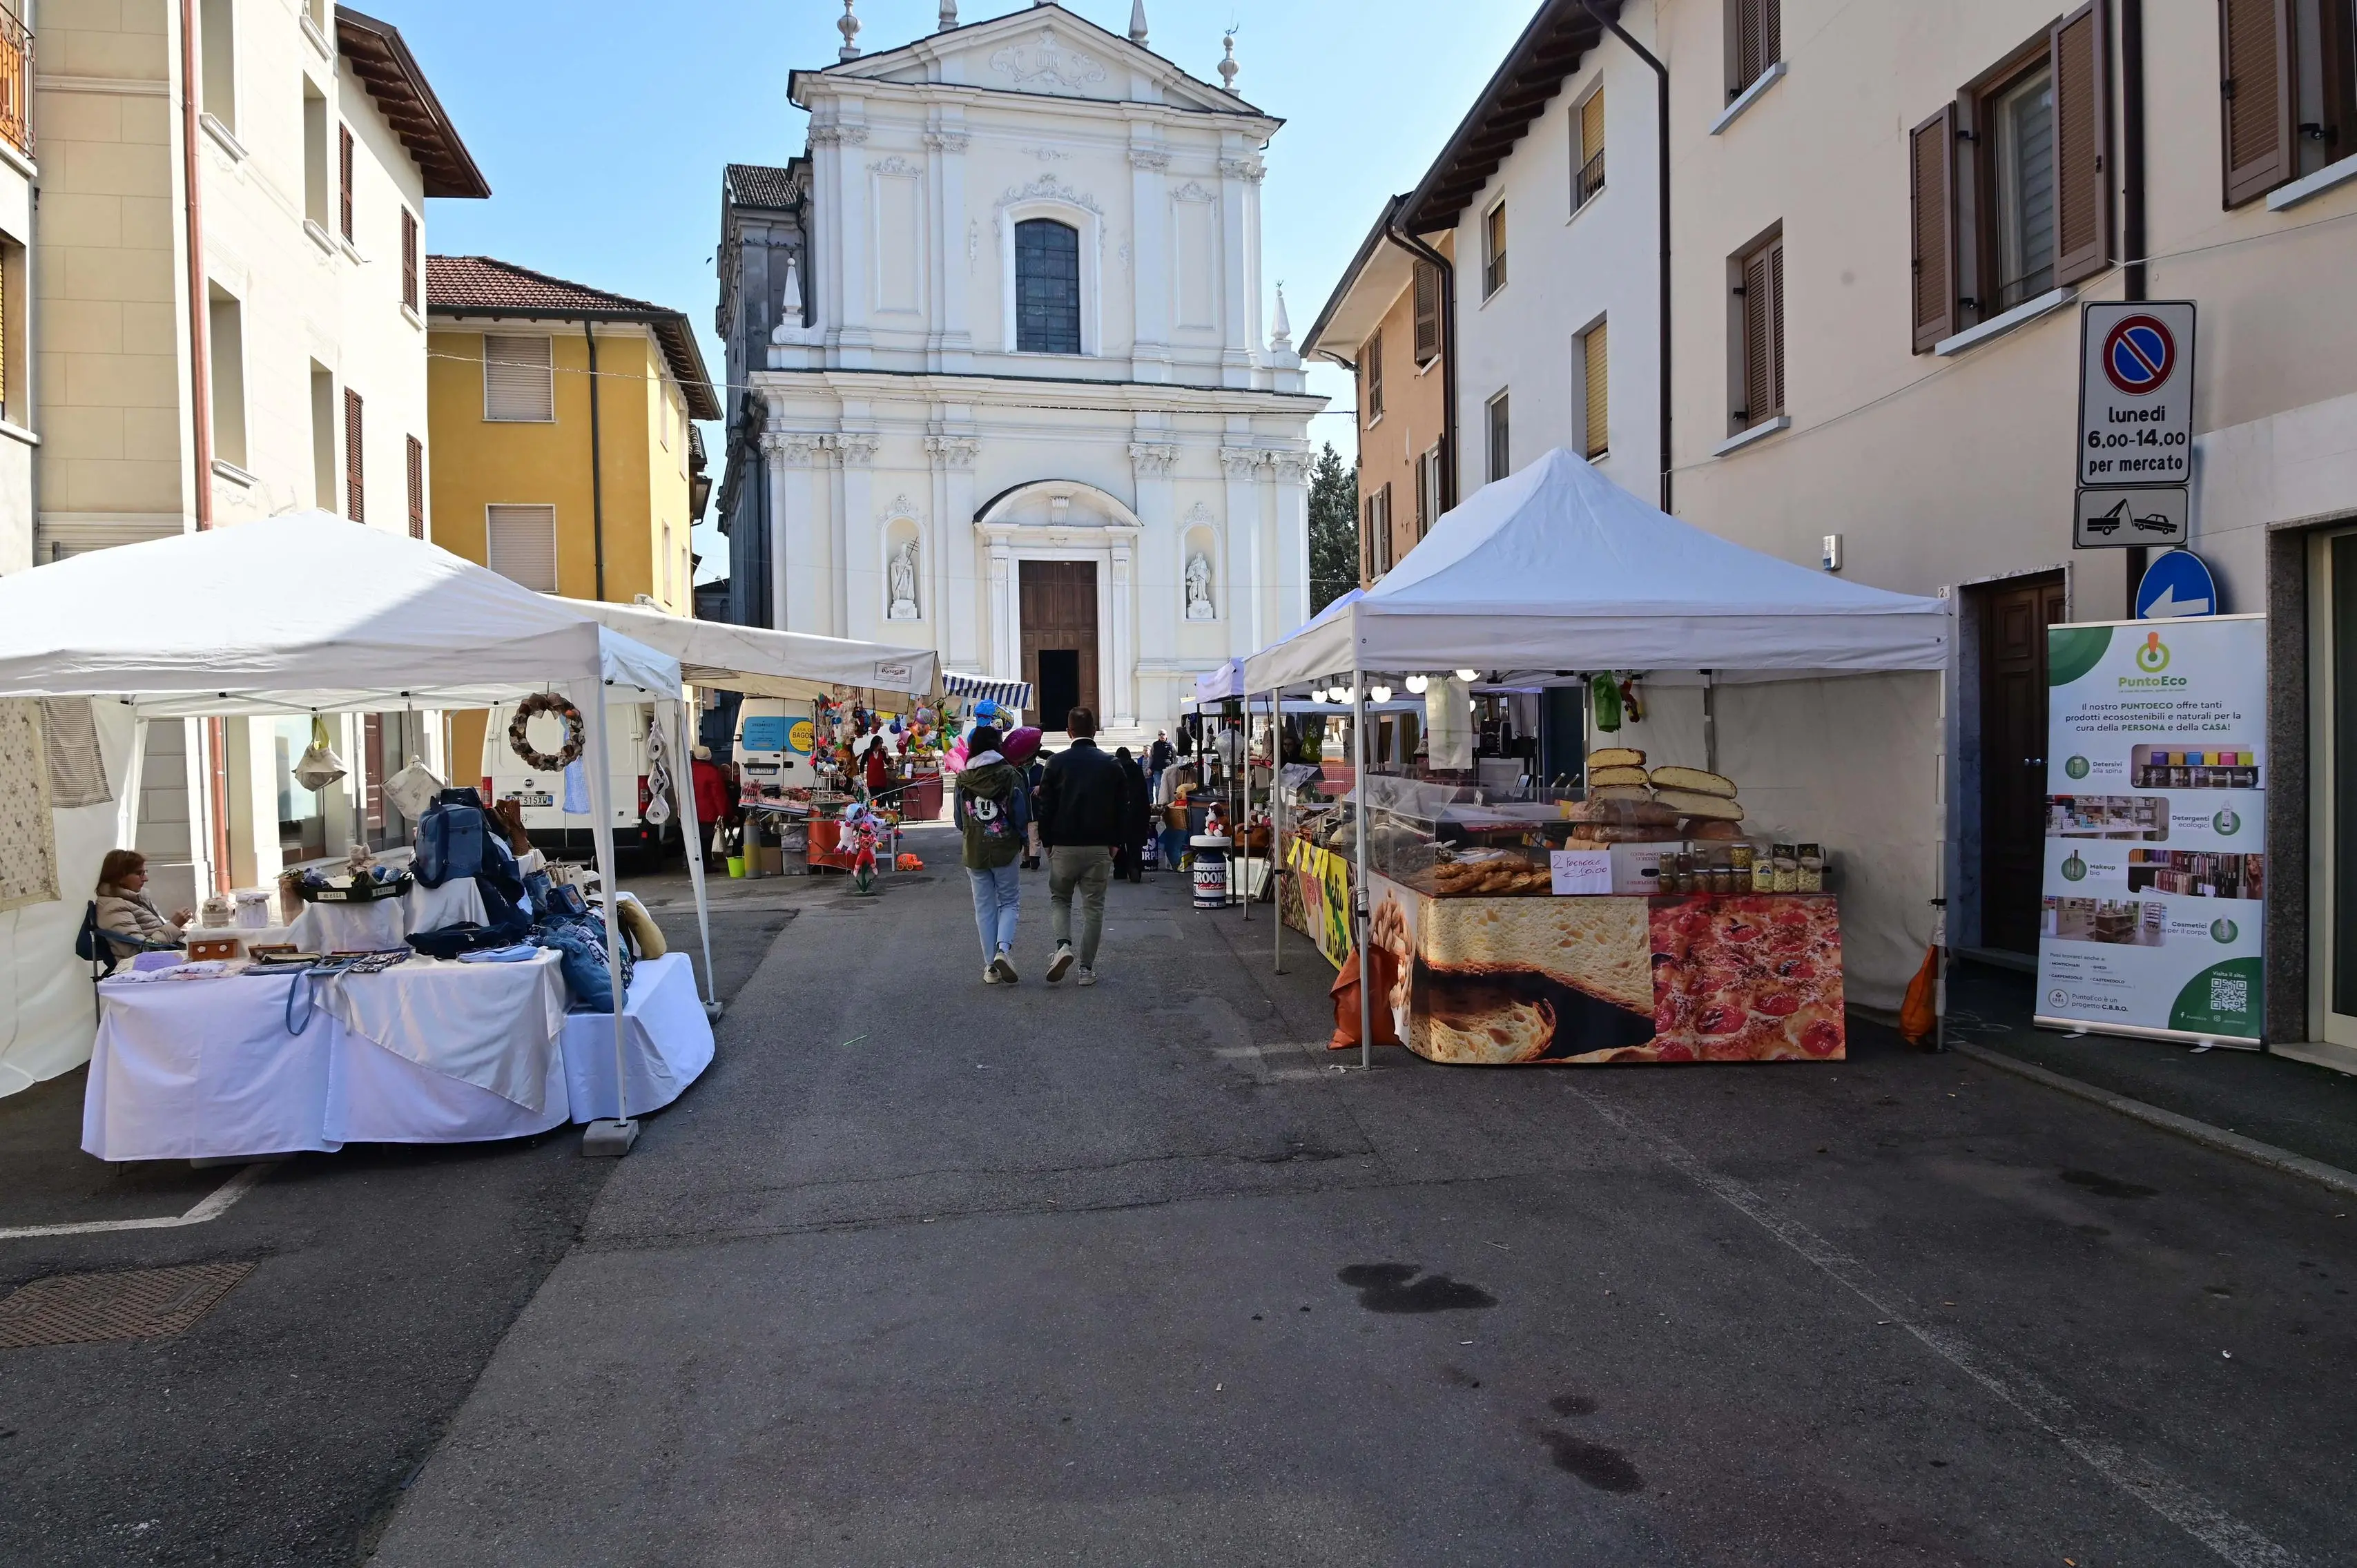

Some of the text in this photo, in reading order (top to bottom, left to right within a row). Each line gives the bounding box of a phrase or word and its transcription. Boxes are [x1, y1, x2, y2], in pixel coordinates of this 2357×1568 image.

[2108, 405, 2165, 423] lunedi
[2089, 454, 2183, 476] per mercato
[2118, 676, 2187, 687] PuntoEco
[2176, 701, 2198, 709] offre
[2200, 701, 2222, 709] tanti
[2066, 713, 2100, 723] prodotti
[2103, 713, 2165, 721] ecosostenibili
[2214, 713, 2231, 722] per
[2176, 723, 2199, 731] della
[1553, 855, 1563, 869] 2
